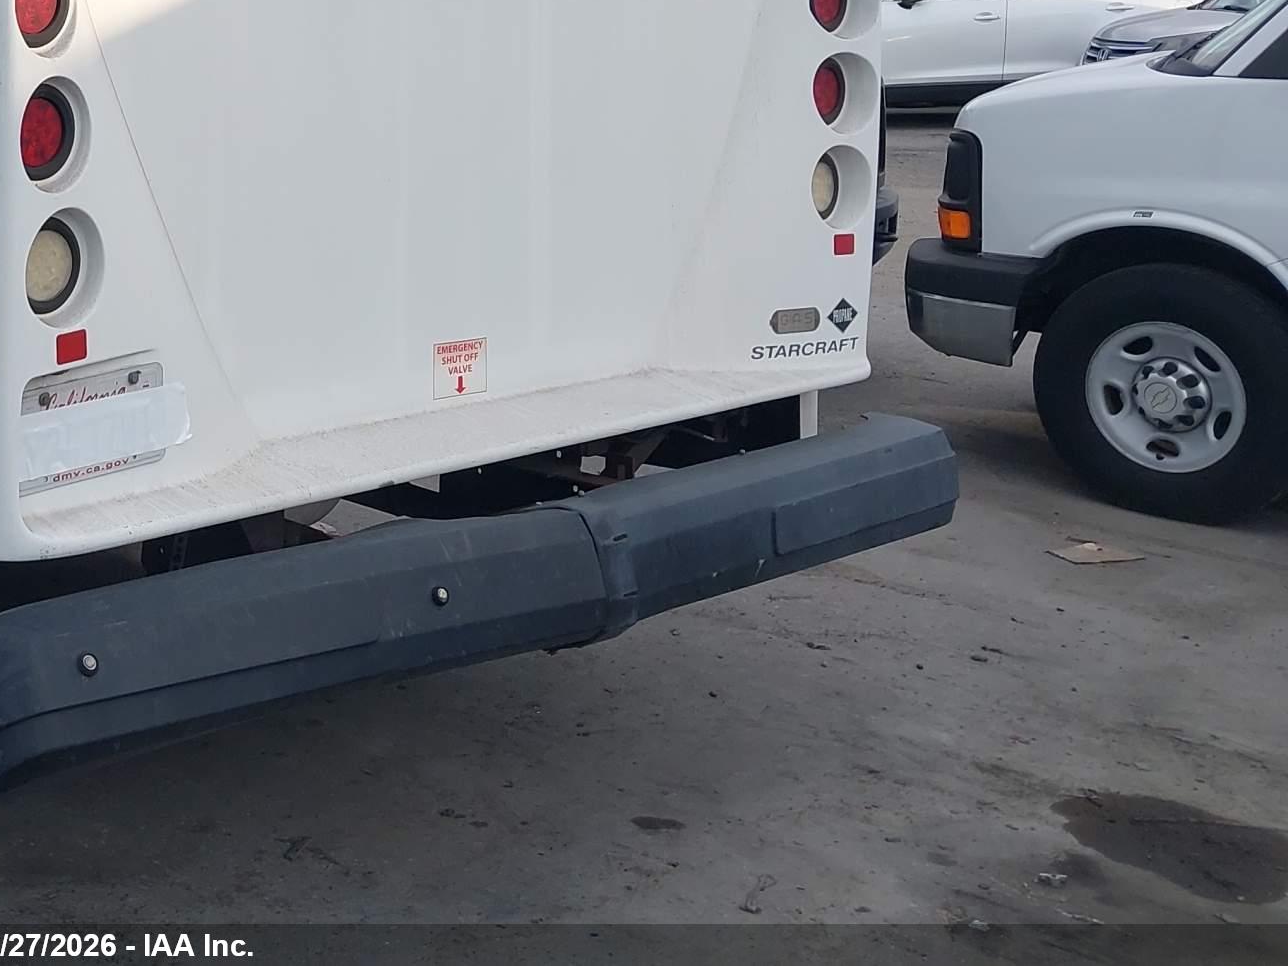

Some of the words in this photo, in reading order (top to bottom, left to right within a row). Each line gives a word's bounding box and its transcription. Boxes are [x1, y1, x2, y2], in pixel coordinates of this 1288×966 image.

[437, 340, 483, 355] EMERGENCY
[751, 337, 859, 360] STARCRAFT
[441, 355, 462, 366] SHUT
[464, 353, 478, 362] OFF
[448, 364, 472, 375] VALVE
[53, 457, 129, 483] dmv.ca.gov
